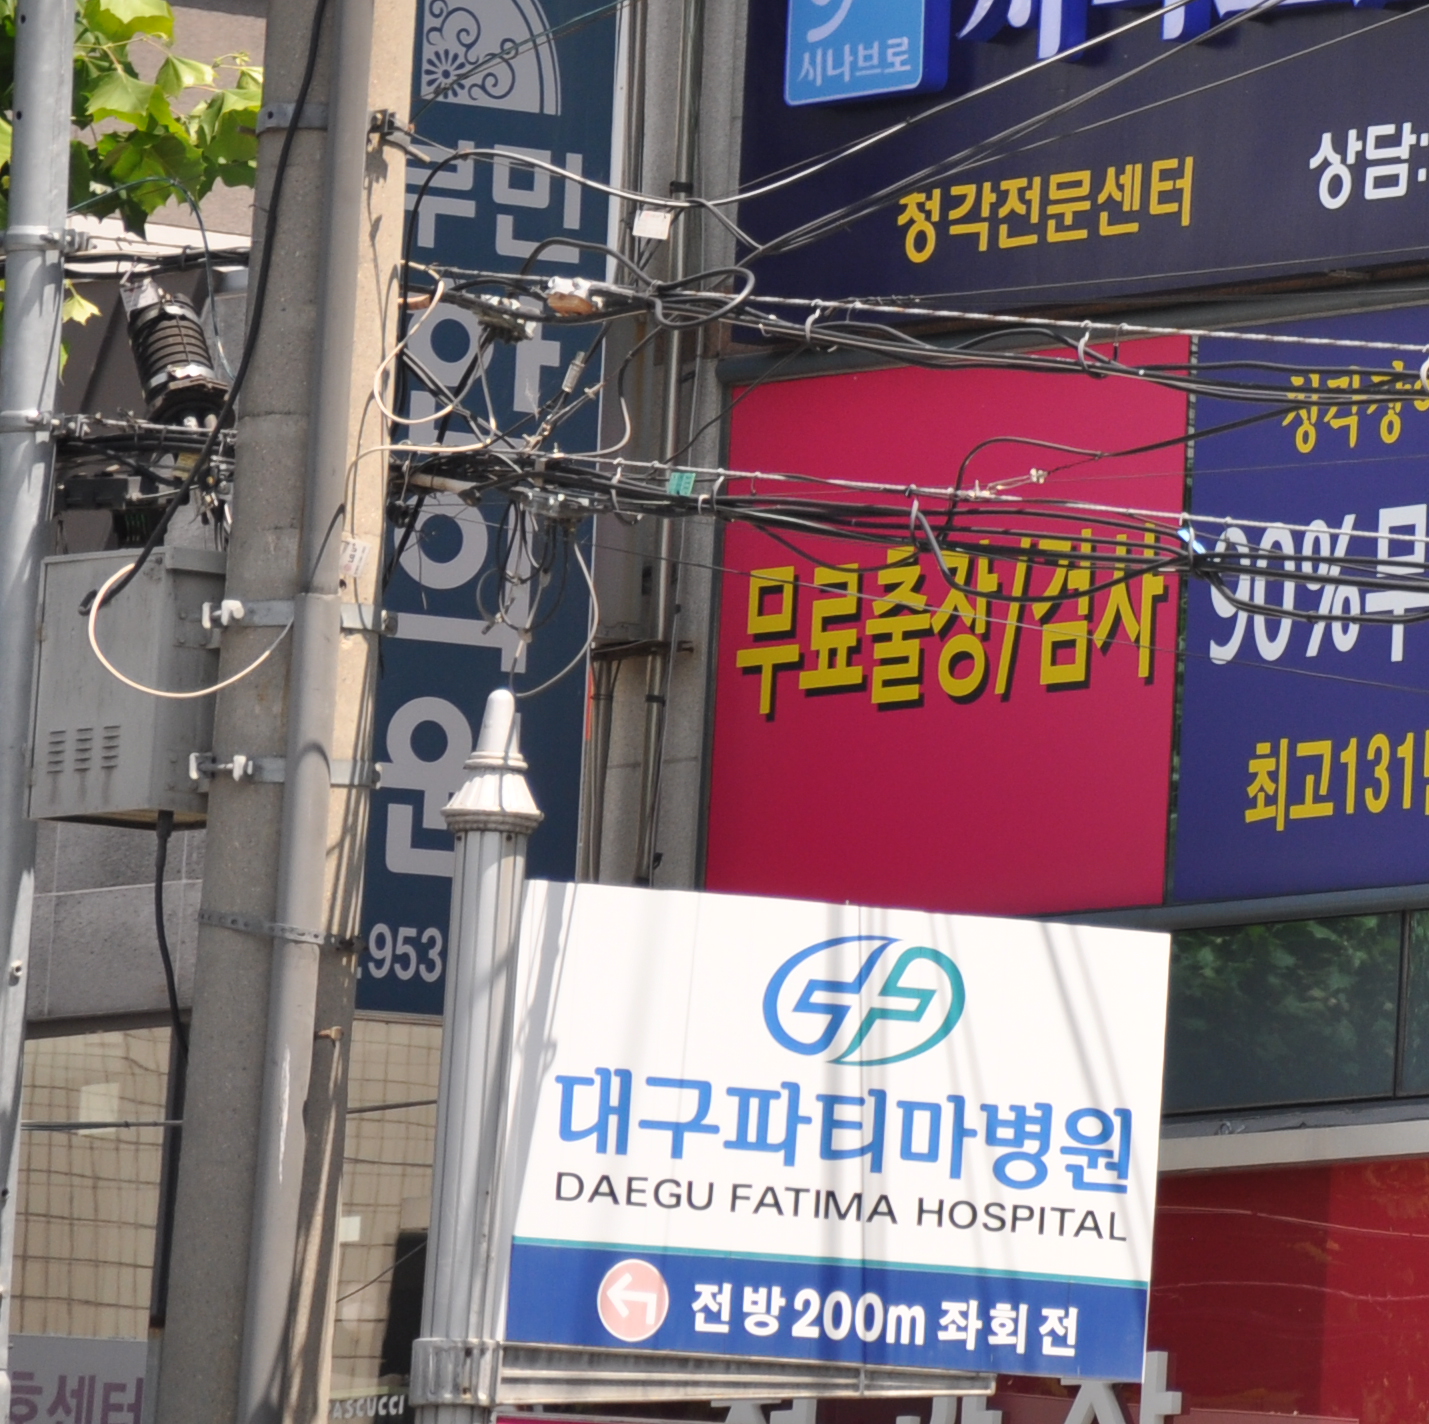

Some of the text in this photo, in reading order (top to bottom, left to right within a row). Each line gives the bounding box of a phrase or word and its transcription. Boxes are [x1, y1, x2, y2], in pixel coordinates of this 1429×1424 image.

[798, 36, 911, 86] 시나브로
[1309, 122, 1429, 209] 상담:
[555, 1067, 1132, 1194] 대구파티마병원
[555, 1172, 1127, 1242] DAEGU FATIMA HOSPITAL
[937, 1299, 1079, 1357] 좌회전
[333, 1395, 405, 1419] ASCUCCI
